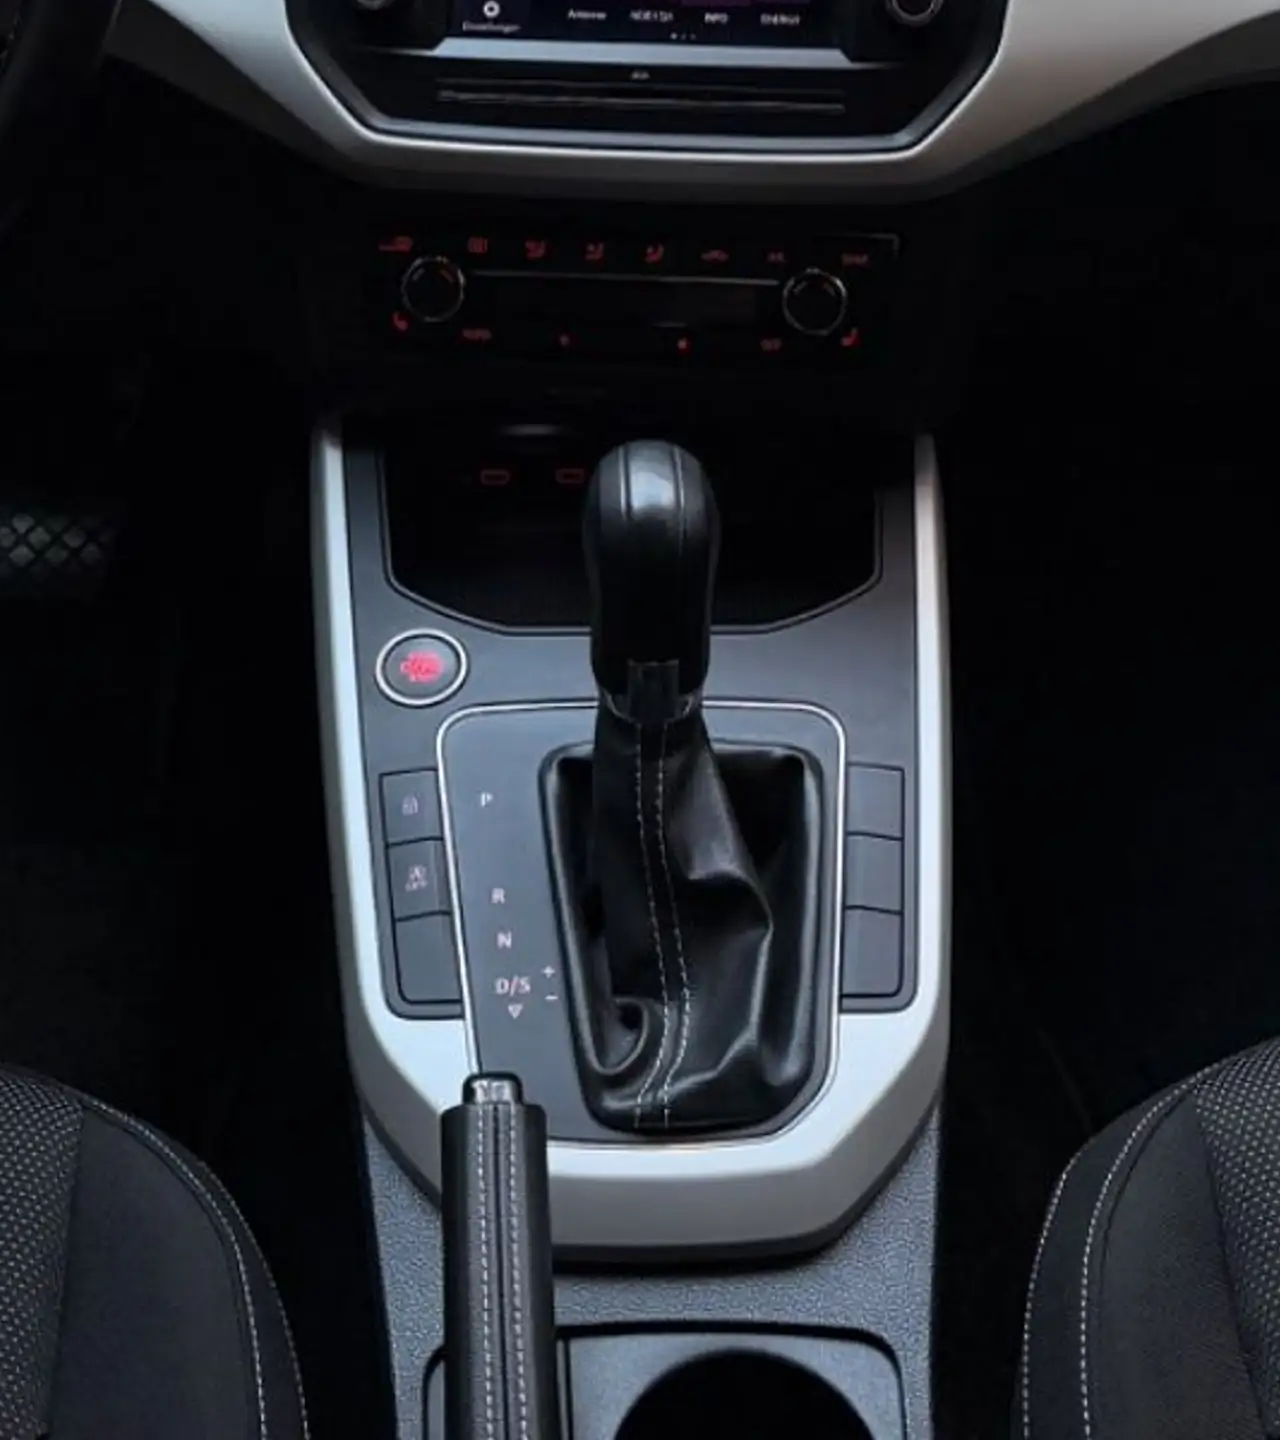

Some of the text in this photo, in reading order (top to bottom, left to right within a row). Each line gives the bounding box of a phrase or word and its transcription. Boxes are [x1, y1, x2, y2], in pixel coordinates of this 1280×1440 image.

[480, 792, 493, 808] P
[491, 888, 506, 904] R
[497, 932, 512, 948] N
[495, 976, 531, 996] D/S
